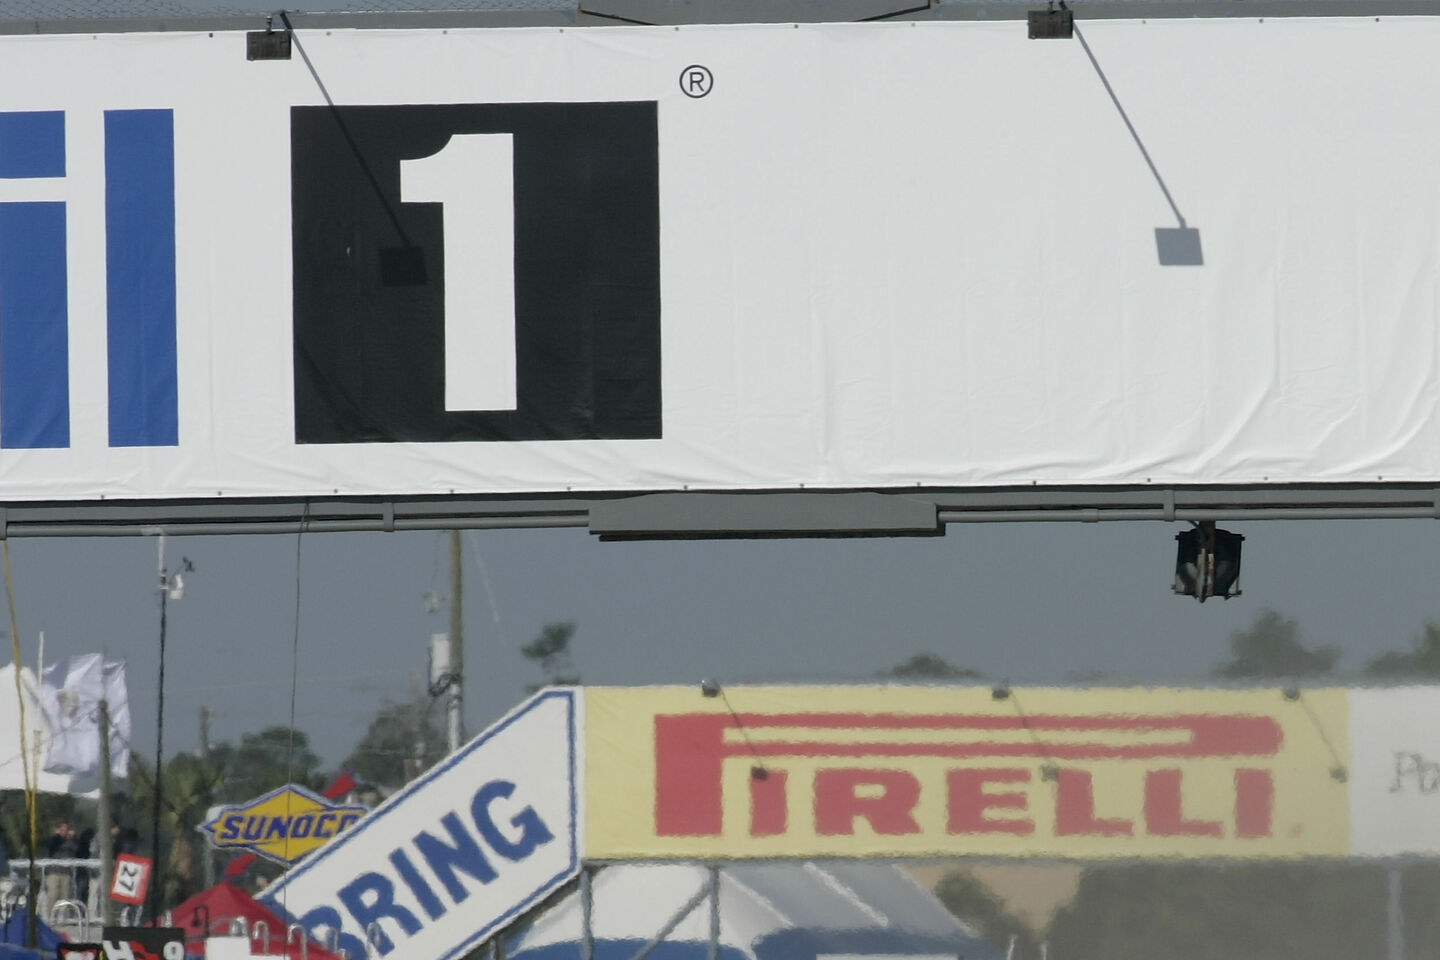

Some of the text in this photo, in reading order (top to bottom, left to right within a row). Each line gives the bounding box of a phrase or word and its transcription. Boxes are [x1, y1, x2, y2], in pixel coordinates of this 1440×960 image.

[400, 133, 517, 411] 1
[653, 712, 1284, 836] PIRELLI
[122, 864, 139, 892] 27
